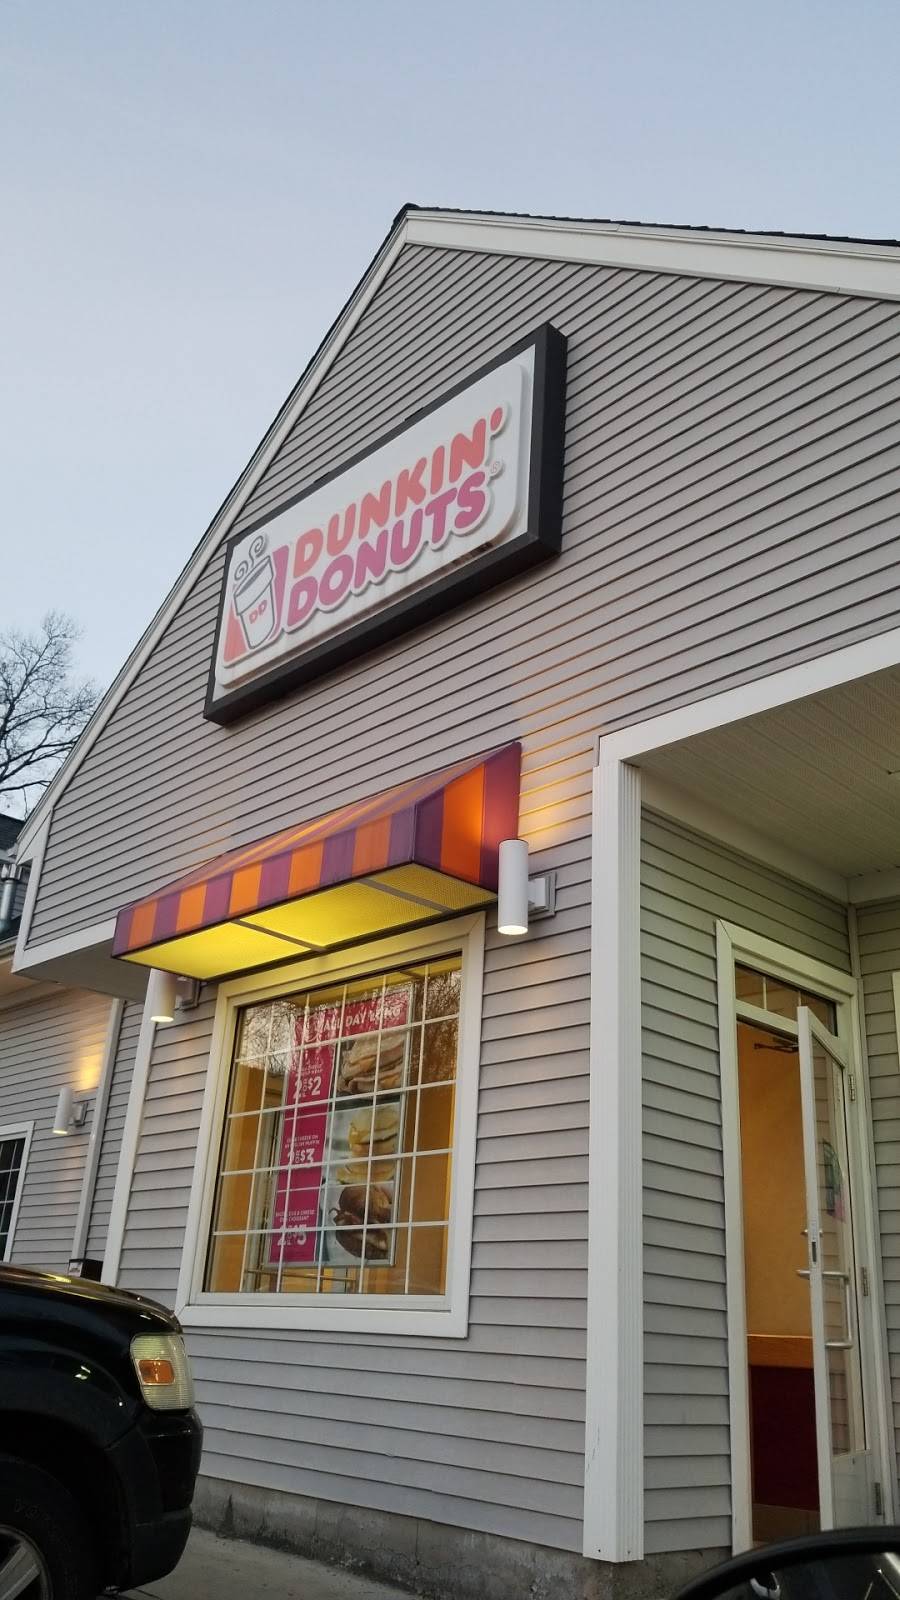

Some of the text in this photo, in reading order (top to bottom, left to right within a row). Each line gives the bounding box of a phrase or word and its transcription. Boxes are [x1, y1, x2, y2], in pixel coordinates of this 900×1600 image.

[293, 407, 503, 578] DUNKIN'
[287, 471, 486, 627] DONUTS
[249, 599, 267, 624] DD
[345, 1008, 367, 1027] DAY
